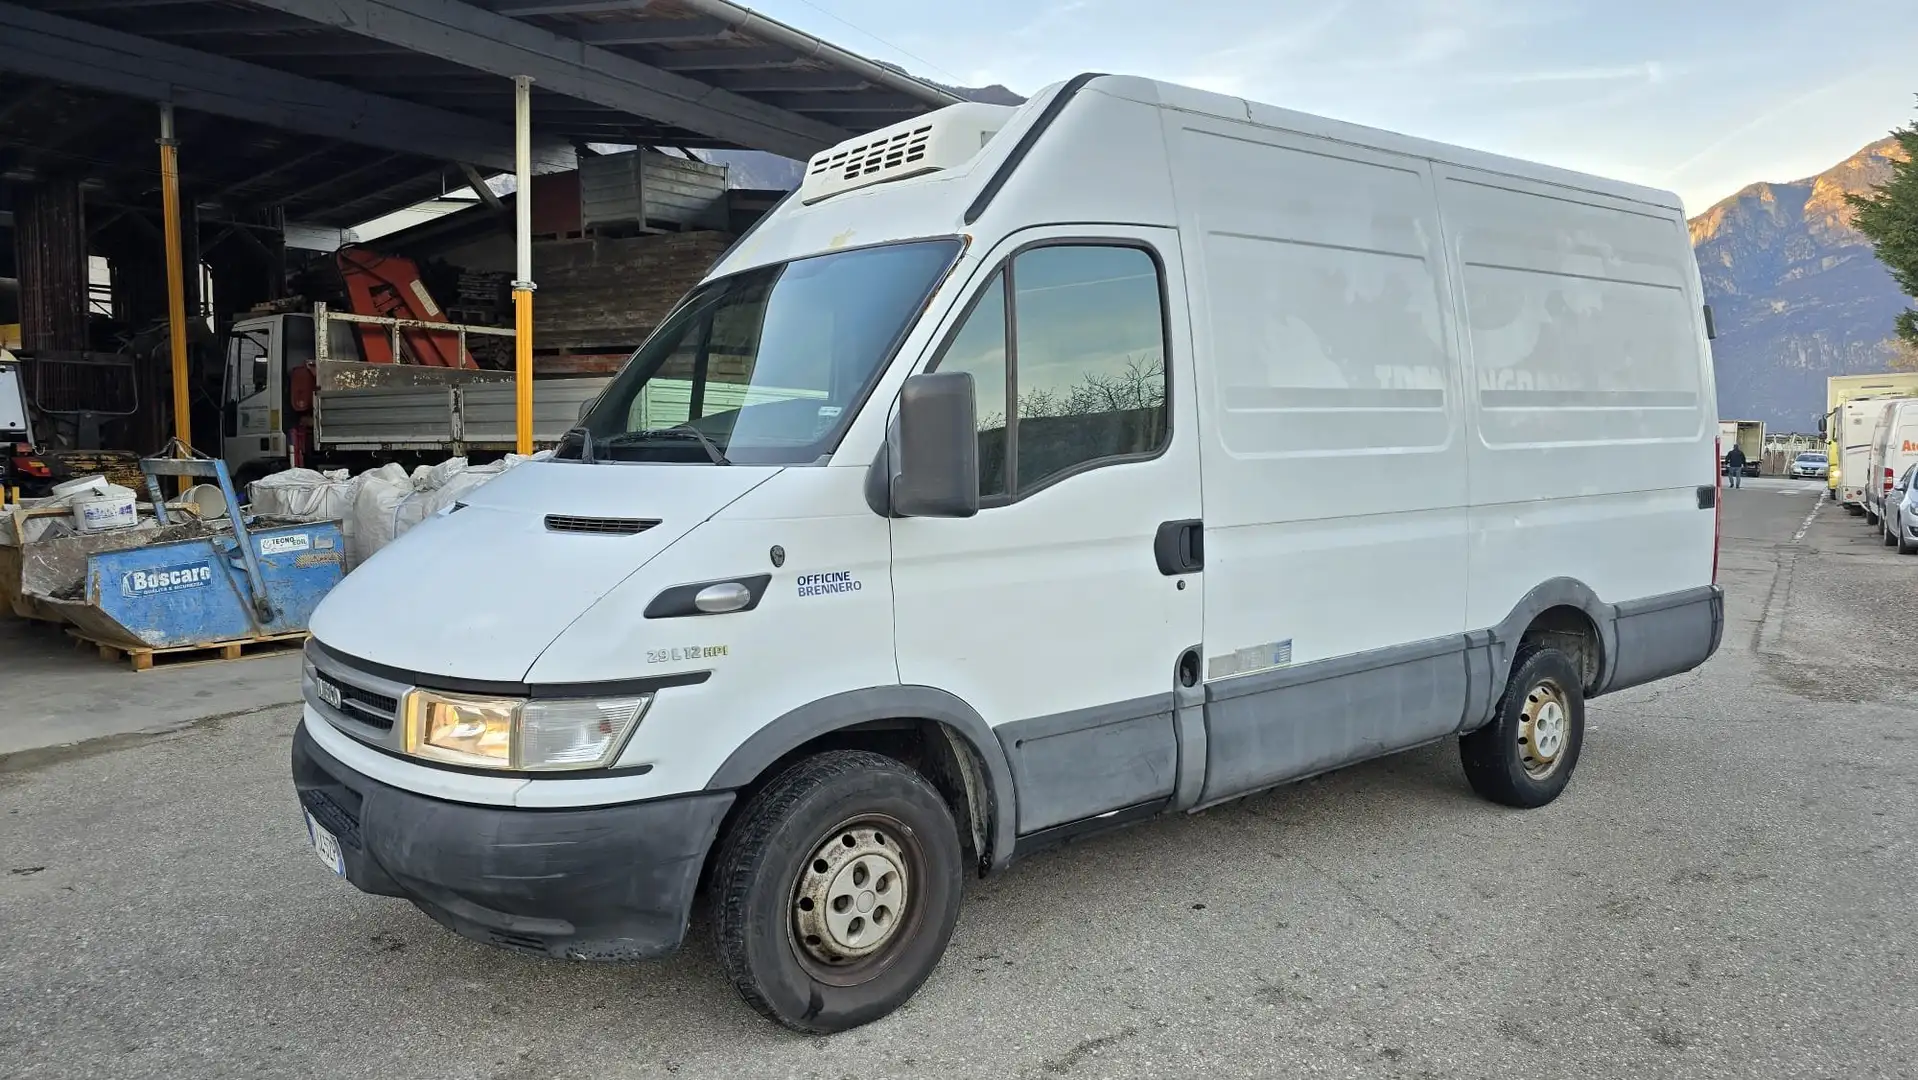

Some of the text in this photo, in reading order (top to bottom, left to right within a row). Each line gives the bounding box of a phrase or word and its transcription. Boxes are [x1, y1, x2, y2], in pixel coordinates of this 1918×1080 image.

[271, 536, 295, 546] TECNO
[132, 566, 211, 591] Boscaro
[797, 571, 851, 586] OFFICINE
[798, 580, 862, 597] BRENNERO
[703, 644, 729, 658] HPI
